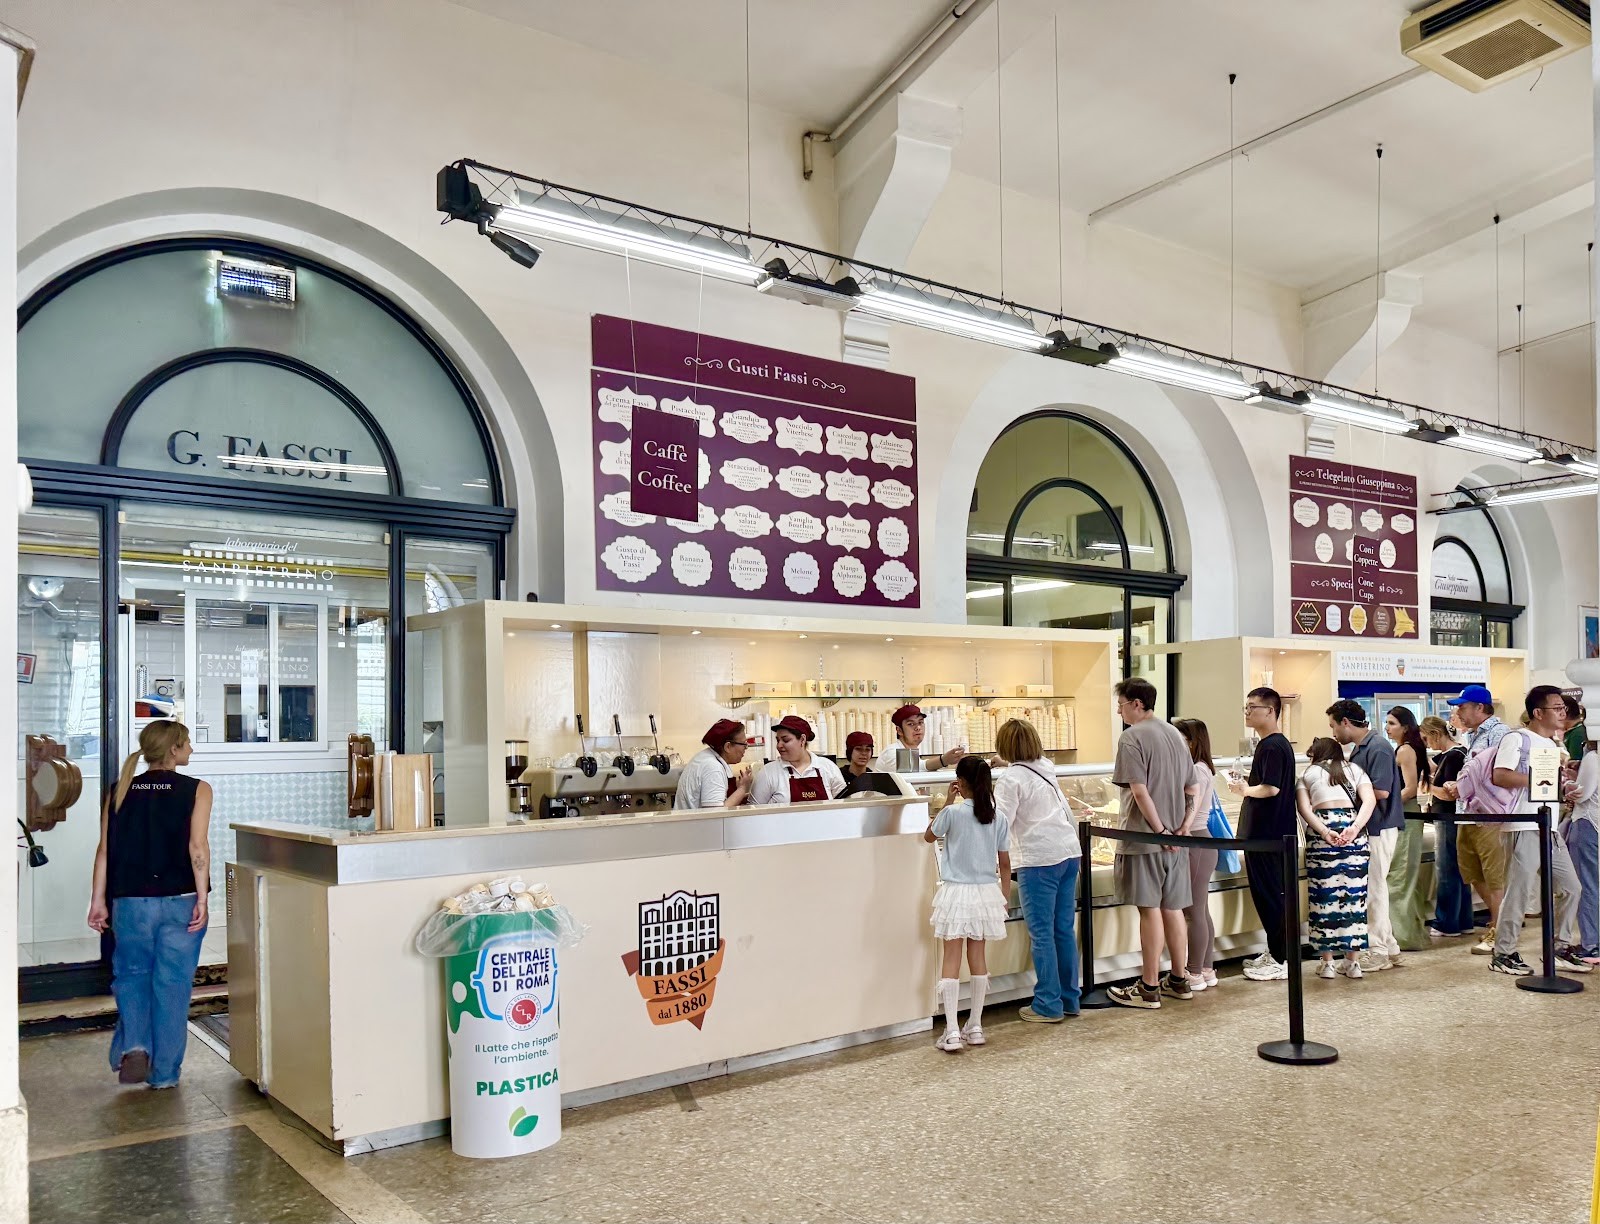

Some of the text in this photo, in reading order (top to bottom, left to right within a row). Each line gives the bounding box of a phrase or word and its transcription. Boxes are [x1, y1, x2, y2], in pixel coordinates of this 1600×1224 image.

[728, 358, 808, 385] Gusti Fassi
[606, 394, 630, 404] Crema
[671, 404, 706, 416] Pistacchio
[725, 418, 737, 426] alla
[786, 421, 813, 431] Nocciola
[167, 430, 206, 467] G.
[222, 435, 352, 483] FASSI
[726, 462, 766, 473] Stracciatella
[638, 470, 692, 494] Coffee
[1316, 468, 1355, 485] Telegelato
[1356, 474, 1395, 491] Giuseppina
[282, 542, 298, 552] del
[616, 545, 648, 554] Gusto di
[1358, 544, 1374, 554] Coni
[618, 553, 645, 562] Andrea
[679, 554, 704, 563] Banana
[736, 558, 761, 566] Limone
[182, 559, 334, 581] SANPIETRINO
[623, 560, 641, 568] Fassi
[730, 563, 767, 573] di Sorrento
[881, 574, 908, 583] YOGURT
[1358, 576, 1374, 588] Cone
[1358, 588, 1374, 602] Cups
[1341, 662, 1390, 671] SANPIETRINO
[491, 947, 550, 966] CENTRALE
[492, 960, 550, 980] DEL LATTE
[493, 974, 550, 993] DI ROMA
[653, 966, 708, 995] FASSI
[658, 992, 707, 1020] dal 1880
[475, 1044, 481, 1053] Il
[483, 1042, 509, 1053] Latte
[511, 1039, 530, 1051] che
[476, 1068, 559, 1096] PLASTICA
